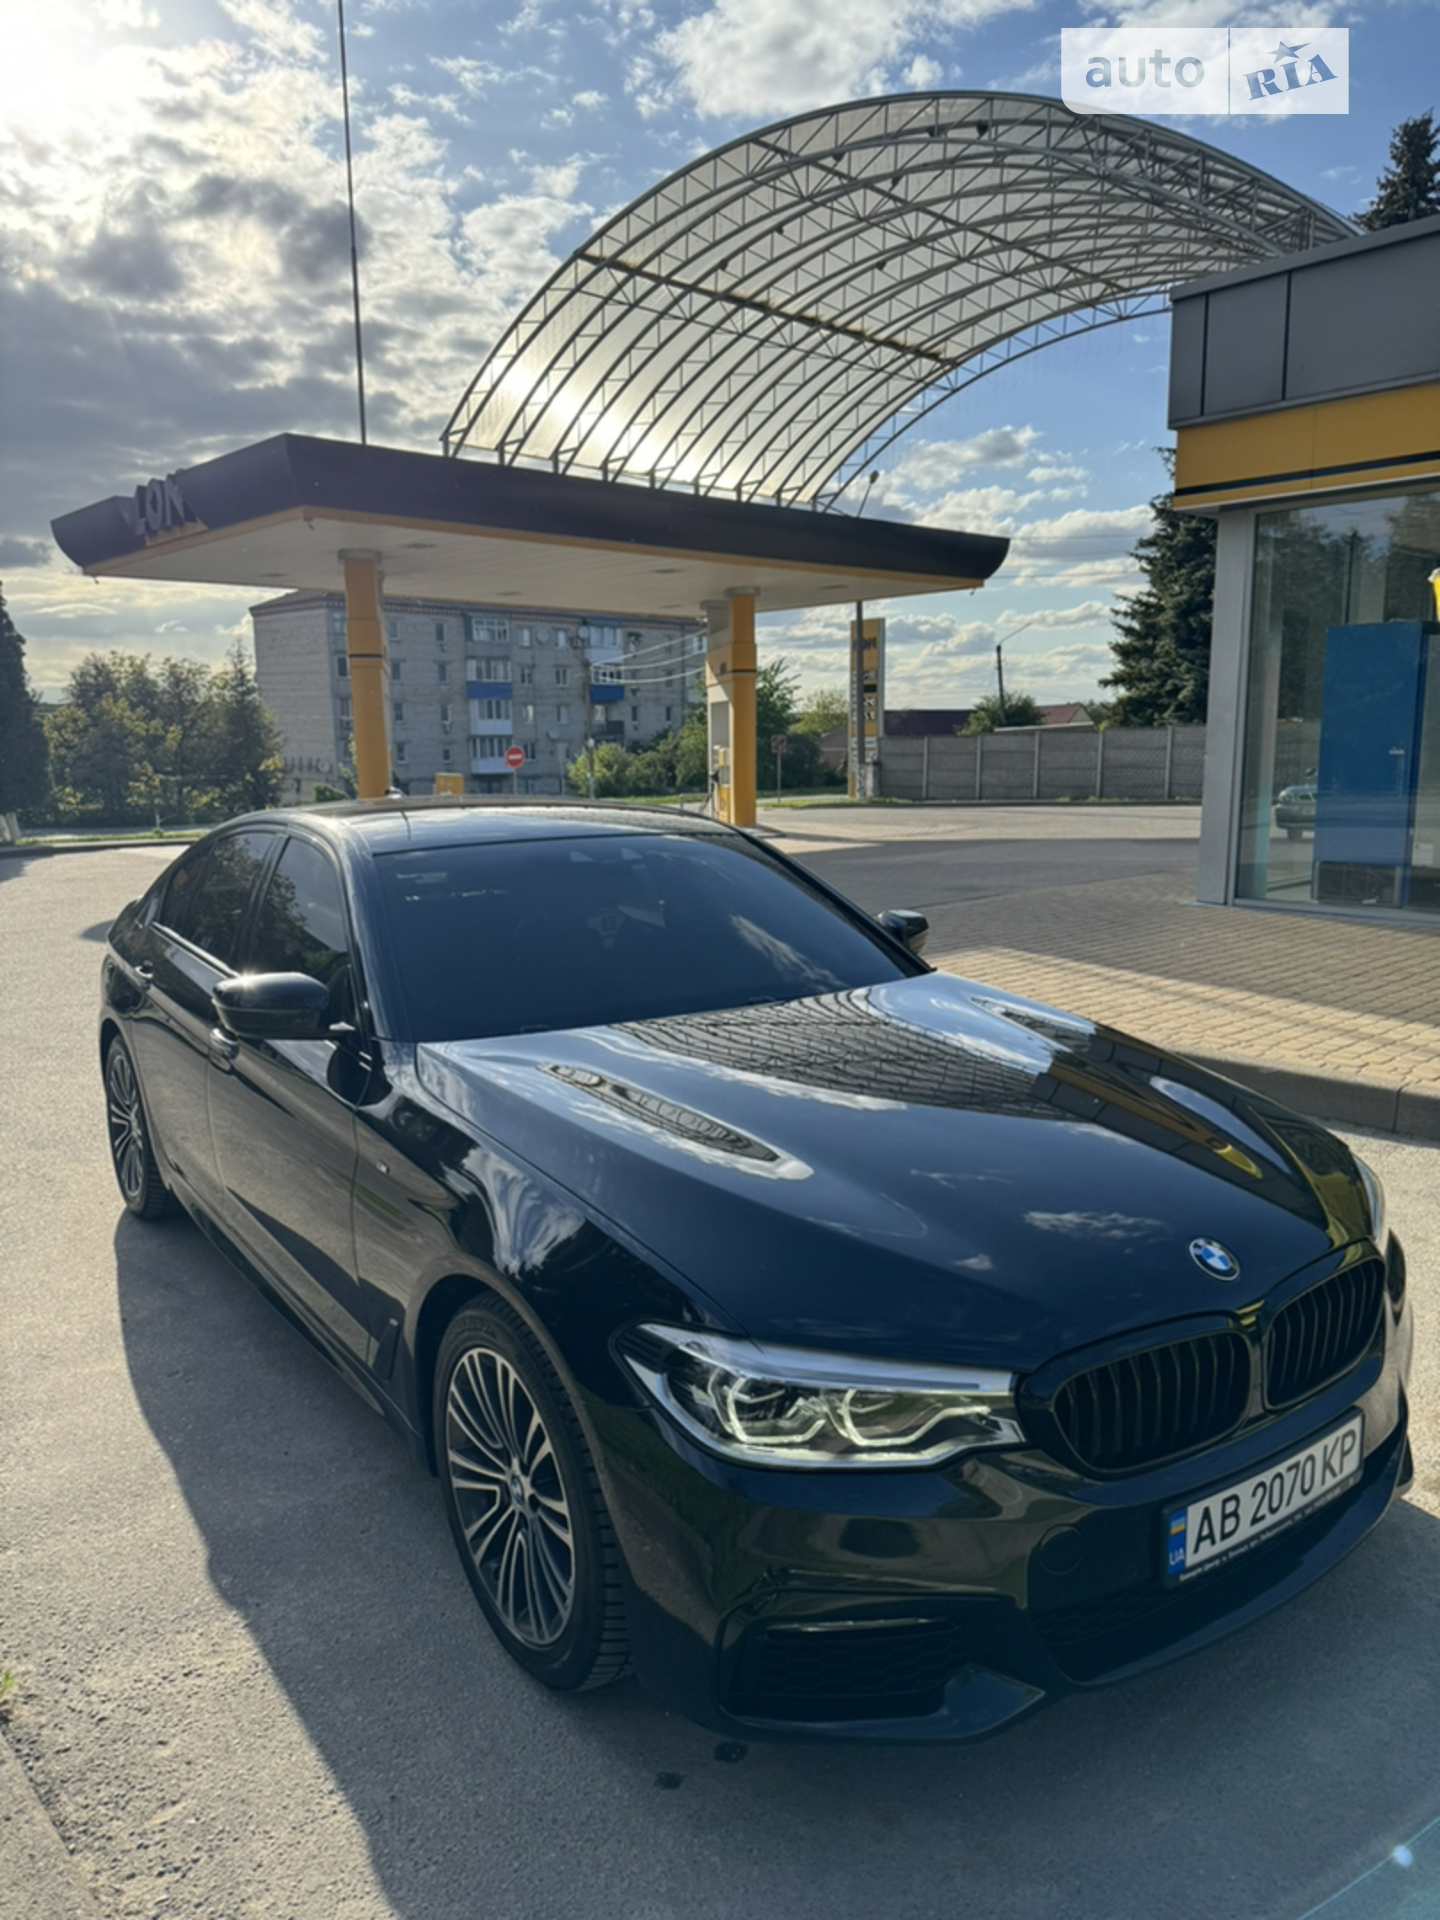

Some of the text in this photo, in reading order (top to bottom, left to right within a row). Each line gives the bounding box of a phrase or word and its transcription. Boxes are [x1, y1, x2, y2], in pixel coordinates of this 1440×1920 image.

[1192, 1493, 1240, 1555] AB
[1250, 1453, 1316, 1527] 2070
[1320, 1429, 1357, 1487] KP
[1168, 1547, 1185, 1566] UA
